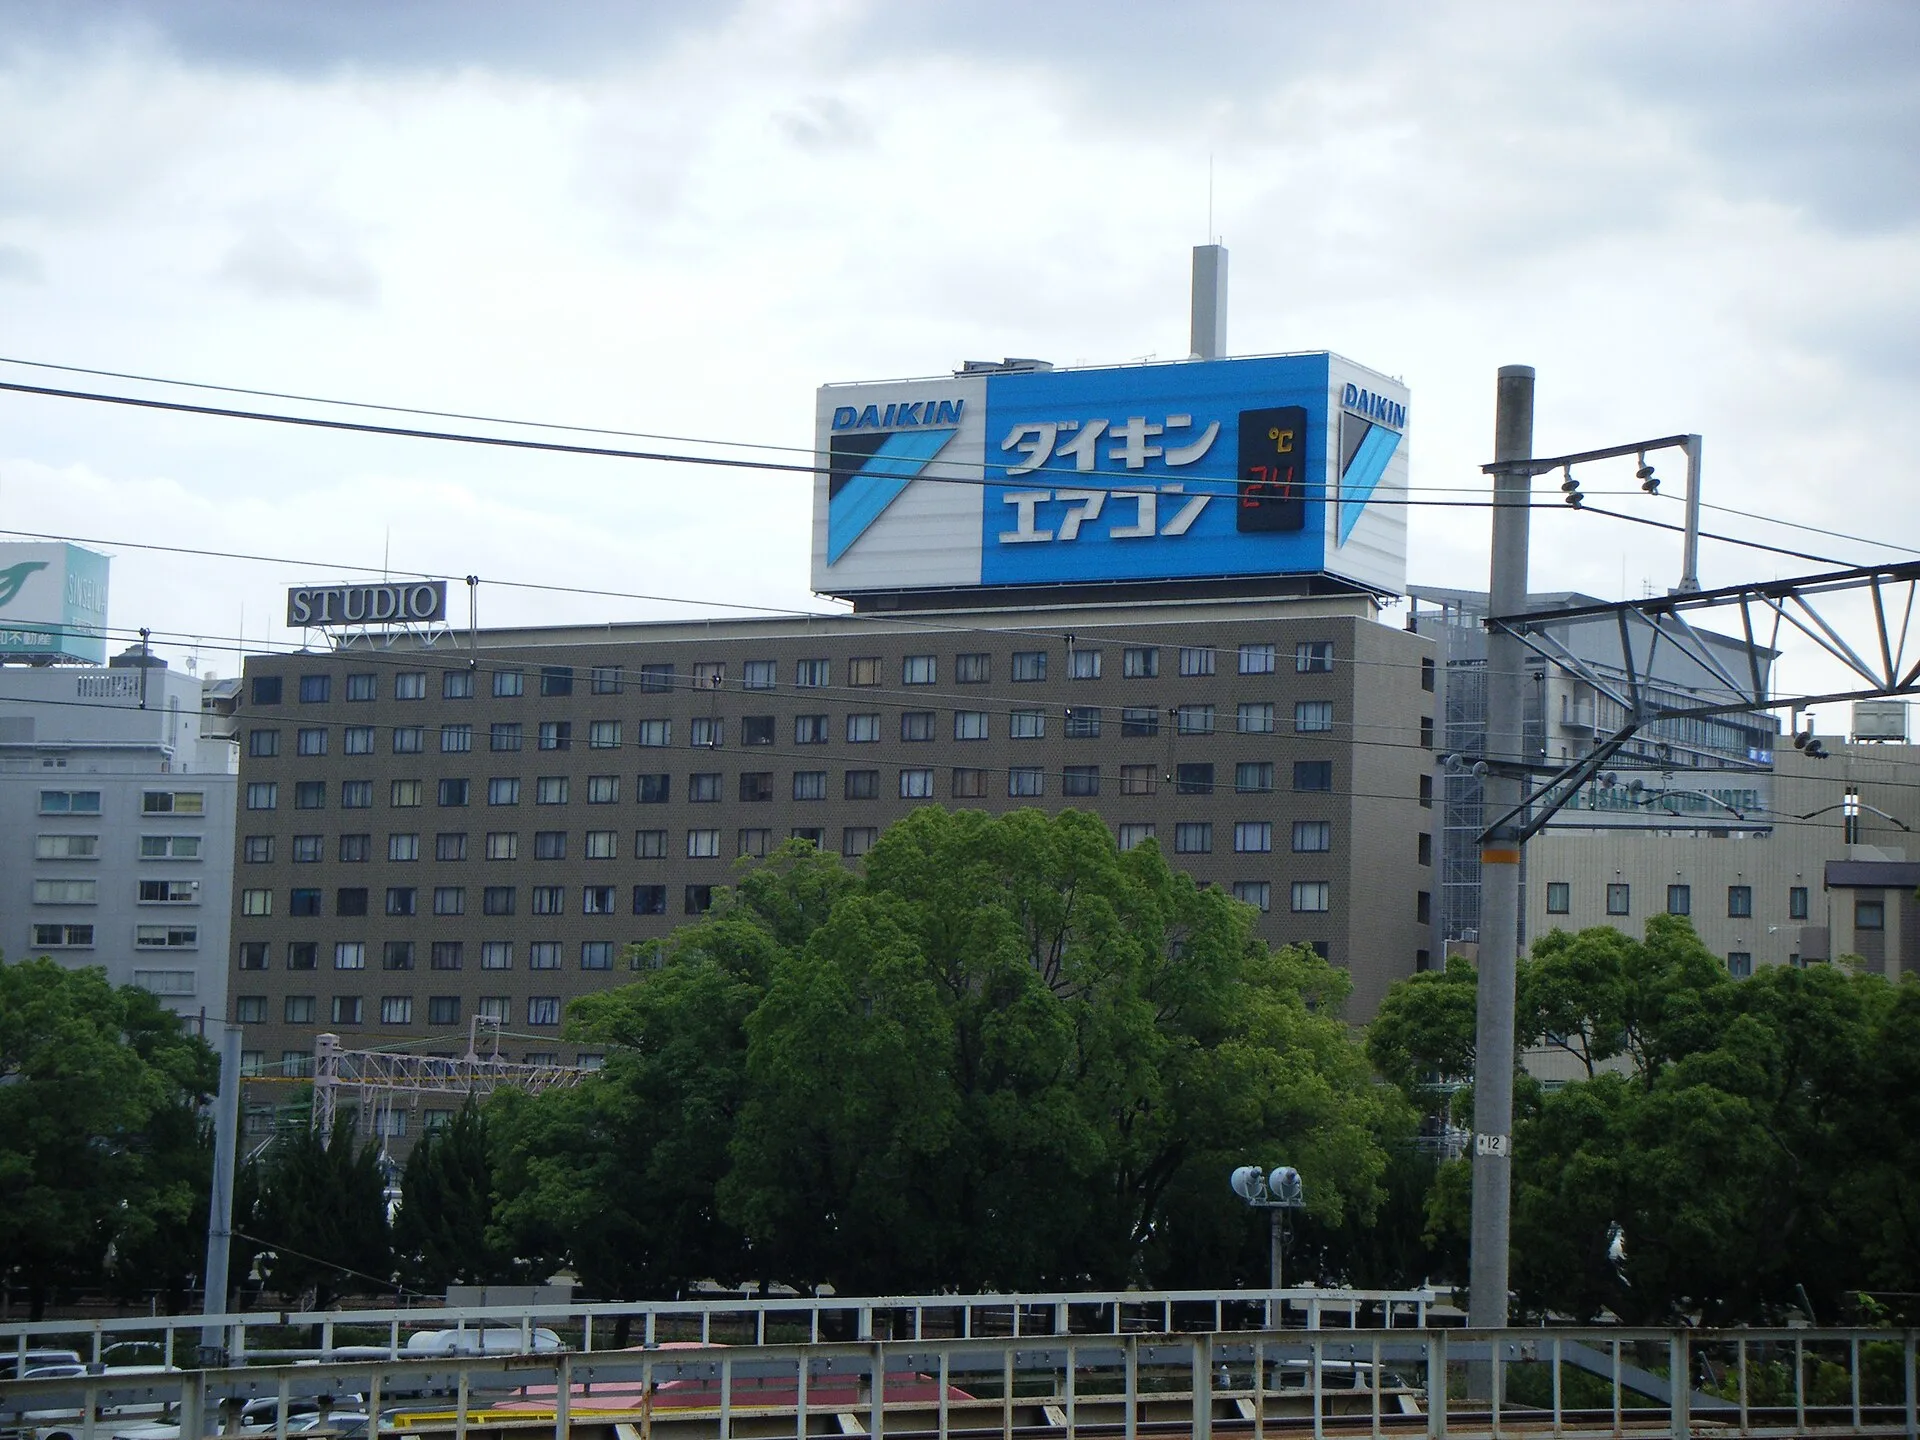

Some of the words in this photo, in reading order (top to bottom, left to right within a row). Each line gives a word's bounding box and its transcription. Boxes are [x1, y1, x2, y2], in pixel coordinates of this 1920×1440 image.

[831, 399, 965, 430] DAIKIN
[1343, 382, 1406, 429] DAIKIN
[1001, 414, 1220, 475] ダイキン
[1243, 466, 1294, 508] 24
[999, 483, 1212, 544] エアコン
[292, 585, 438, 622] STUDIO
[1712, 788, 1762, 812] HOTEL
